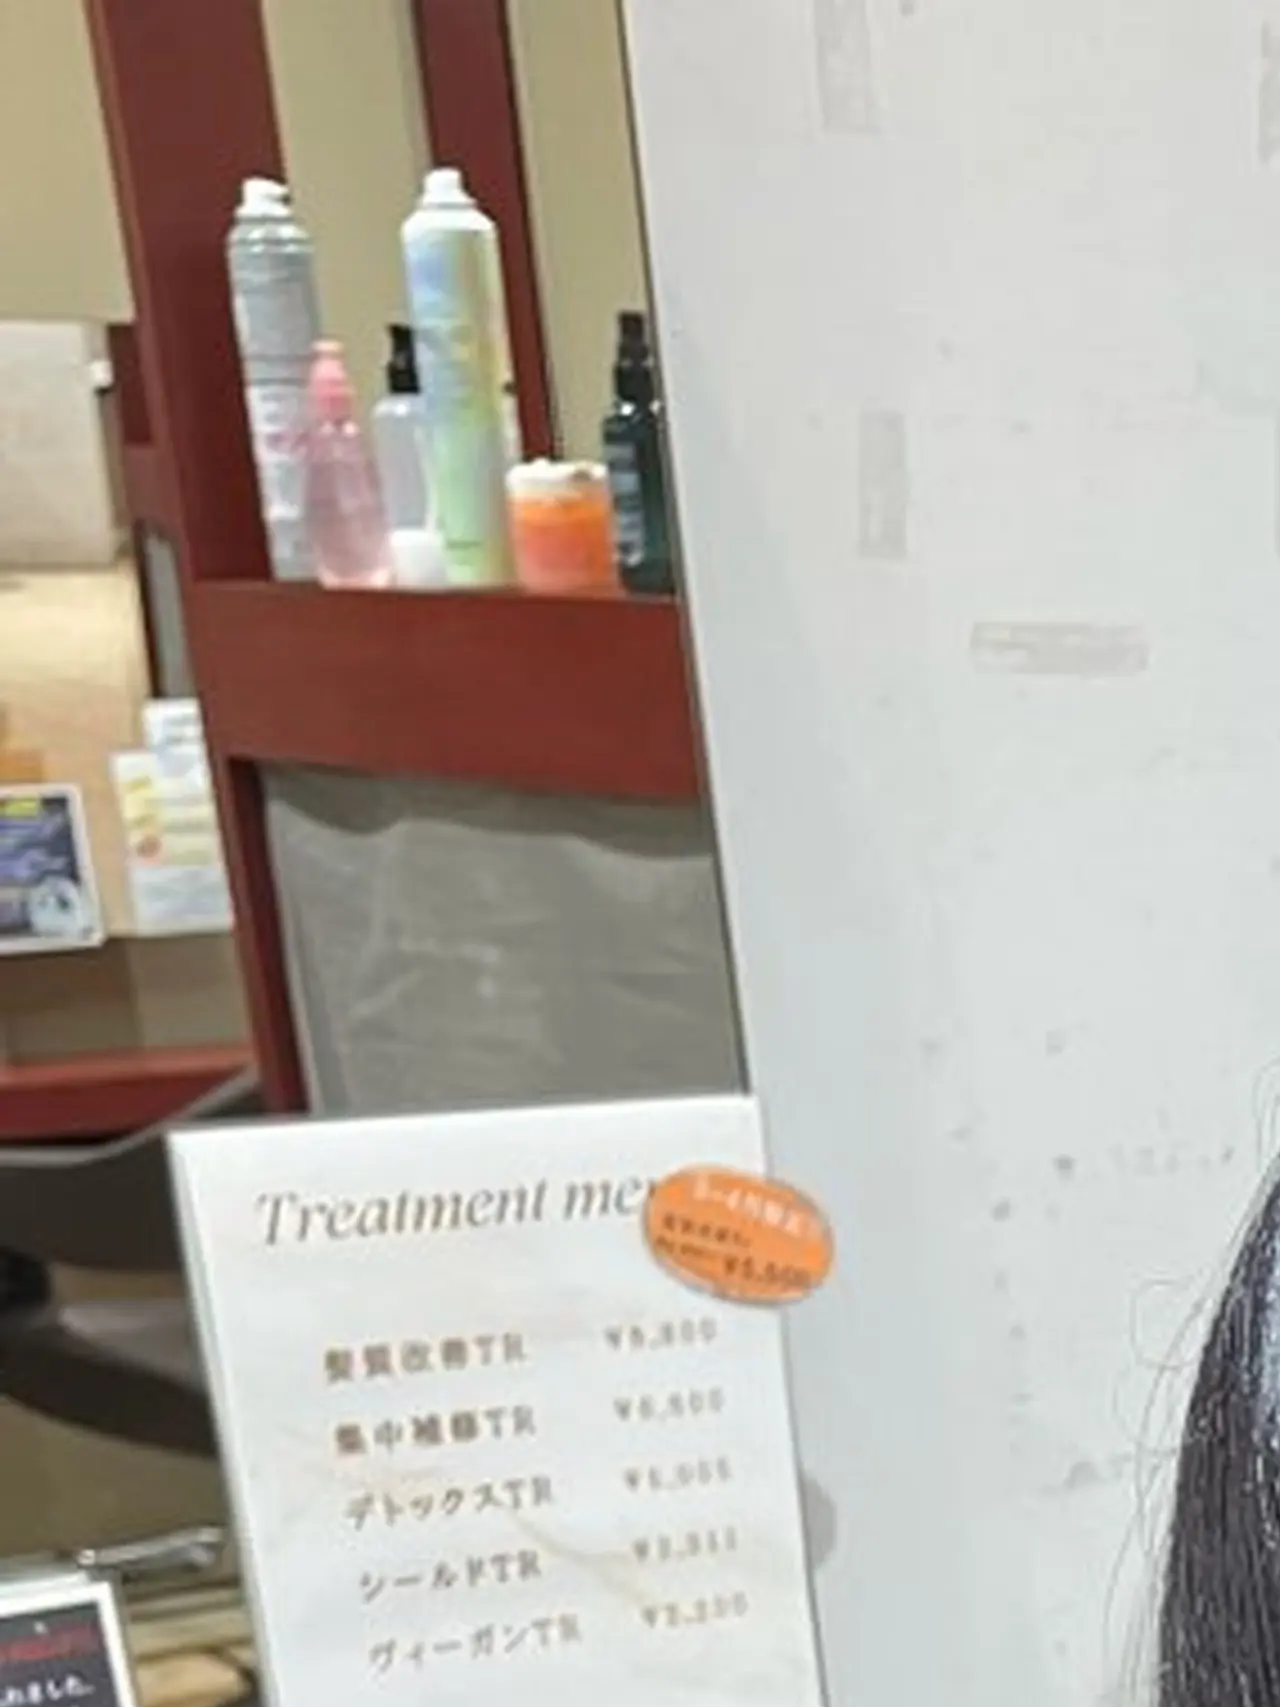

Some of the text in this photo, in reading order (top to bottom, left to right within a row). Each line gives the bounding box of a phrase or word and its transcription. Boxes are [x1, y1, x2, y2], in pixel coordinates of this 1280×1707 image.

[256, 1174, 658, 1246] Treatment me
[344, 1476, 553, 1532] デトックスTR
